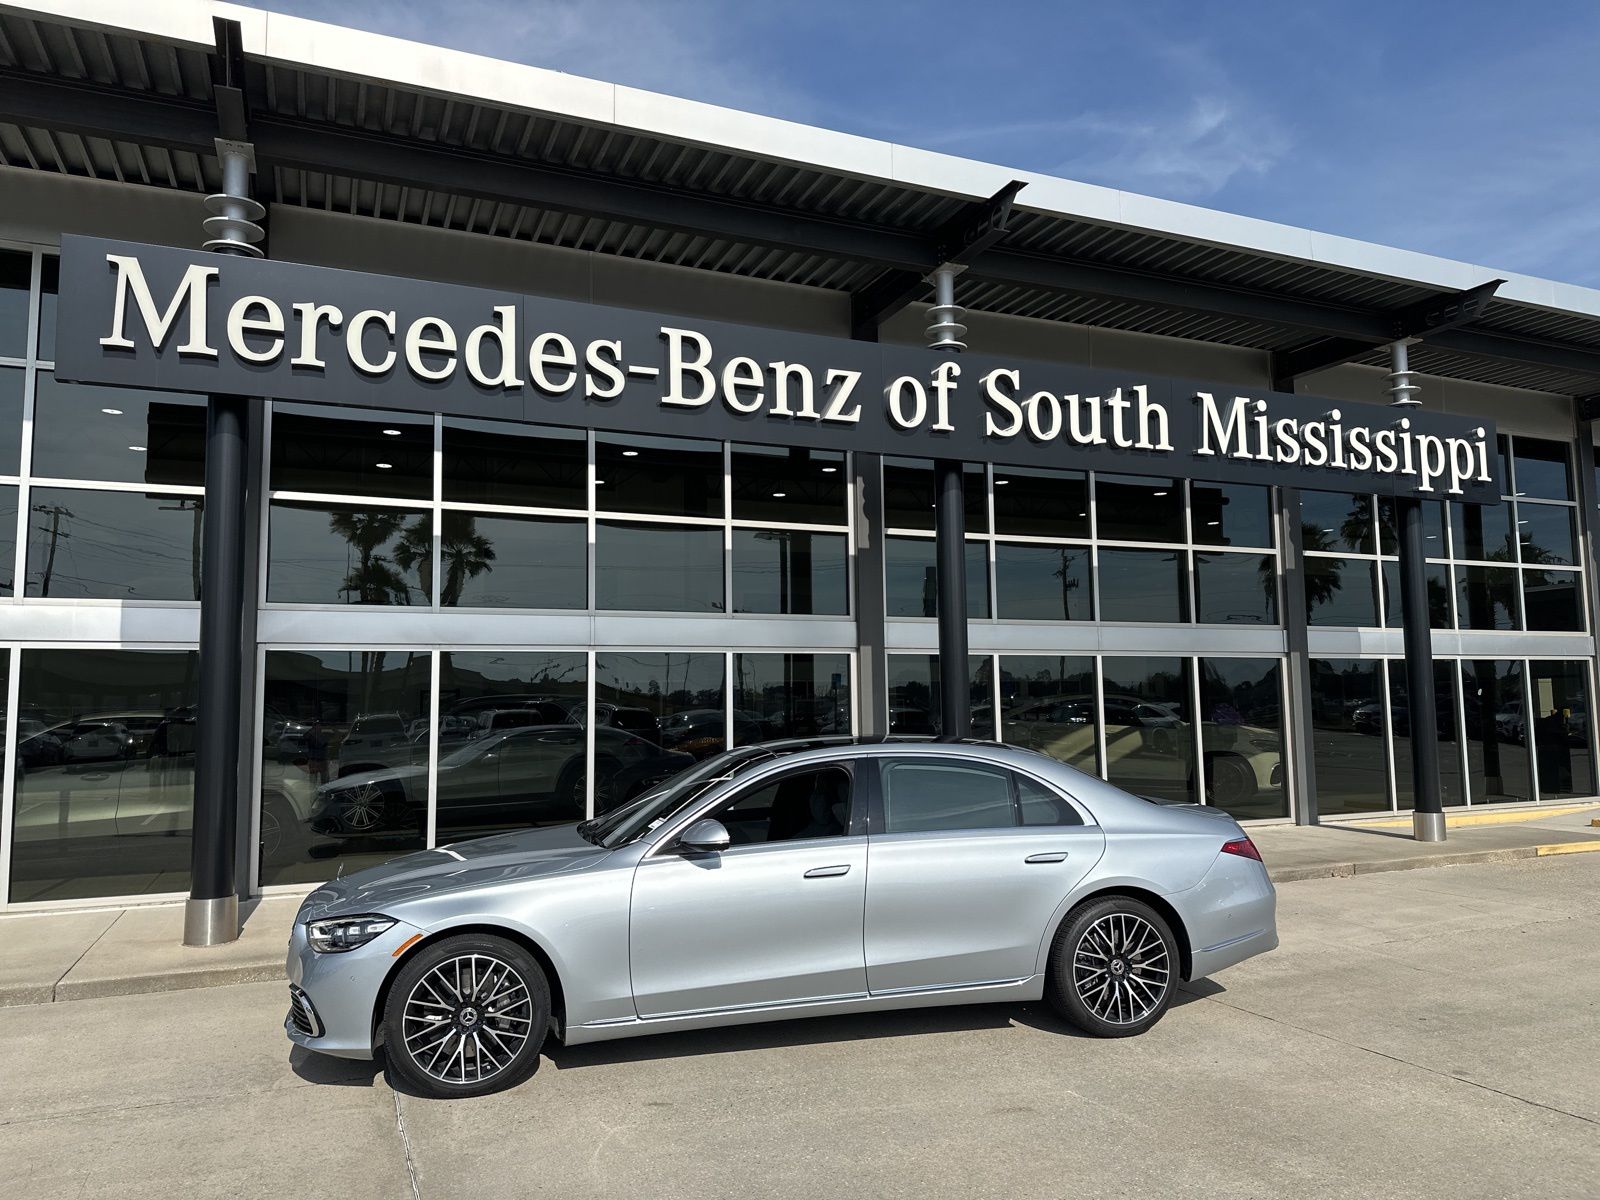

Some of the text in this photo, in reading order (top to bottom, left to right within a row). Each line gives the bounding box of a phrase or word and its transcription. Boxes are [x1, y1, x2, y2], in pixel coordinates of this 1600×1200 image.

[99, 253, 1492, 495] Mercedes-Benz of South Mississippi
